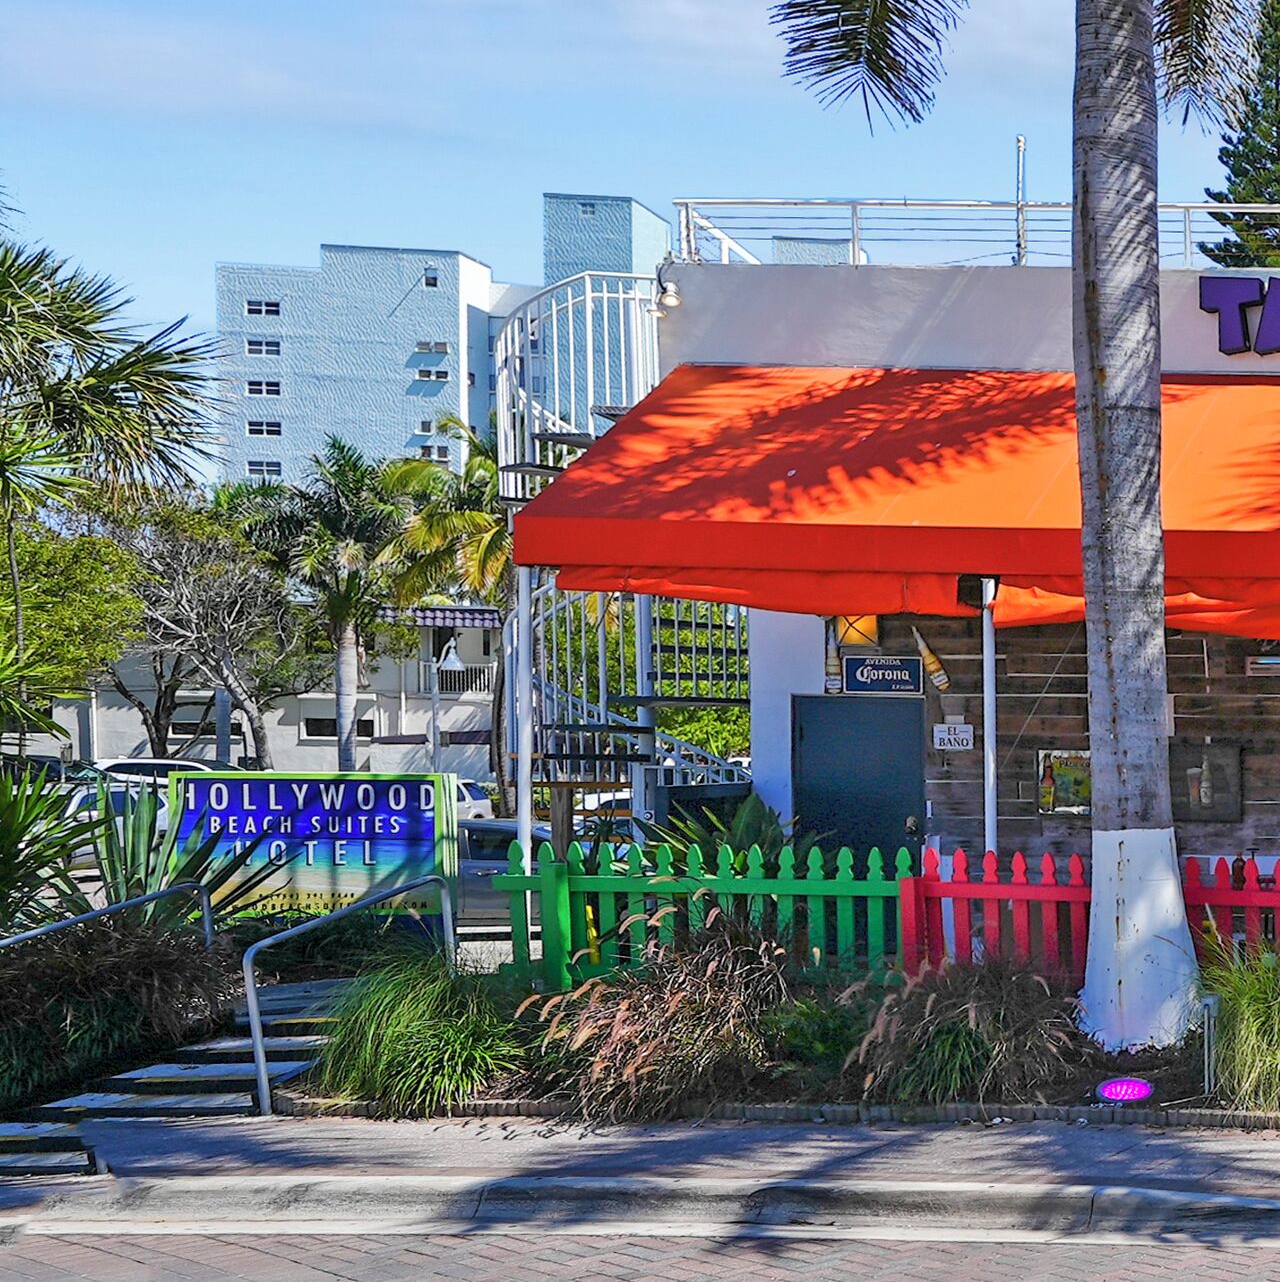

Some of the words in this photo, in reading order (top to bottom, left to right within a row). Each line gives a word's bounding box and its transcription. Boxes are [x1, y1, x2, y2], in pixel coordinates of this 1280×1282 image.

[855, 665, 912, 684] Corona
[947, 726, 960, 735] EL
[178, 783, 434, 811] HOLLYWOOD
[209, 816, 292, 834] BEACH
[311, 816, 401, 835] SUITES
